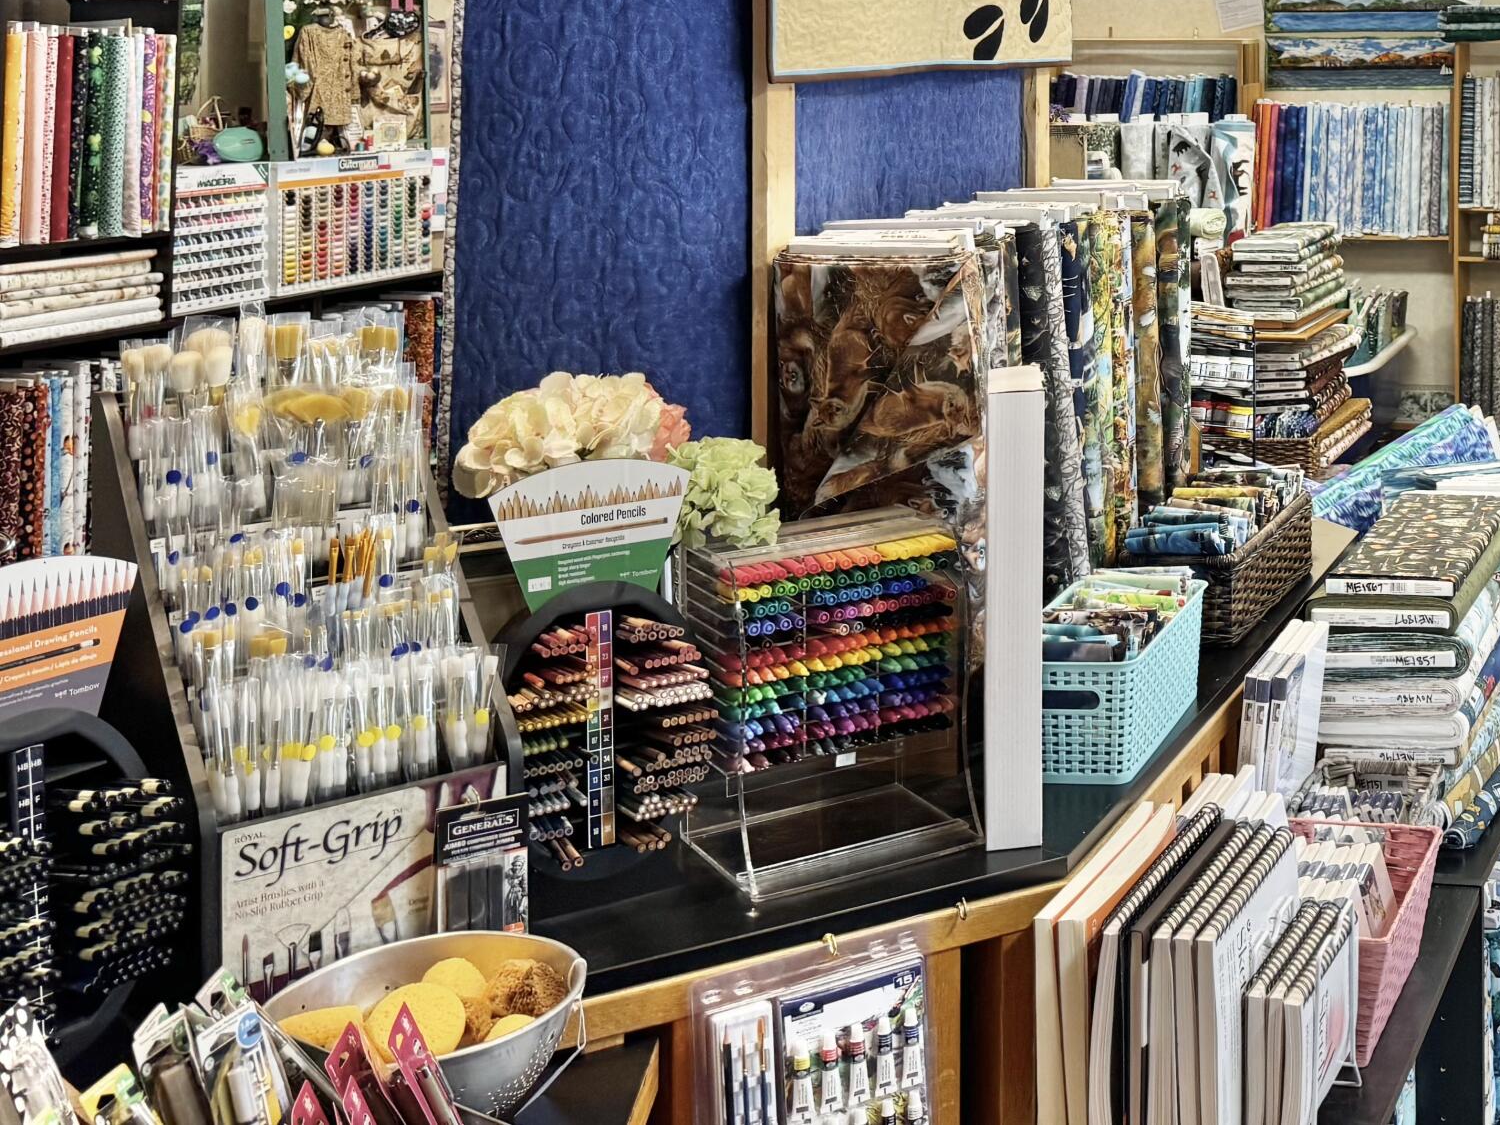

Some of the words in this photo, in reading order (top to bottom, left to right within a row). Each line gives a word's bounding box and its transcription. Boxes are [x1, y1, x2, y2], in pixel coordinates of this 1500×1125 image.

[197, 177, 236, 188] MADEIRA
[581, 509, 614, 526] Colored
[616, 505, 647, 521] Pencils
[34, 632, 68, 649] Drawing
[69, 625, 98, 640] Pencils
[69, 681, 101, 697] Tombow
[35, 794, 41, 804] F
[234, 811, 403, 888] Soft-Grip
[235, 896, 258, 910] Artist
[261, 886, 297, 904] Brushes
[298, 881, 319, 894] with
[269, 896, 301, 912] Rubber
[303, 890, 324, 905] Grip
